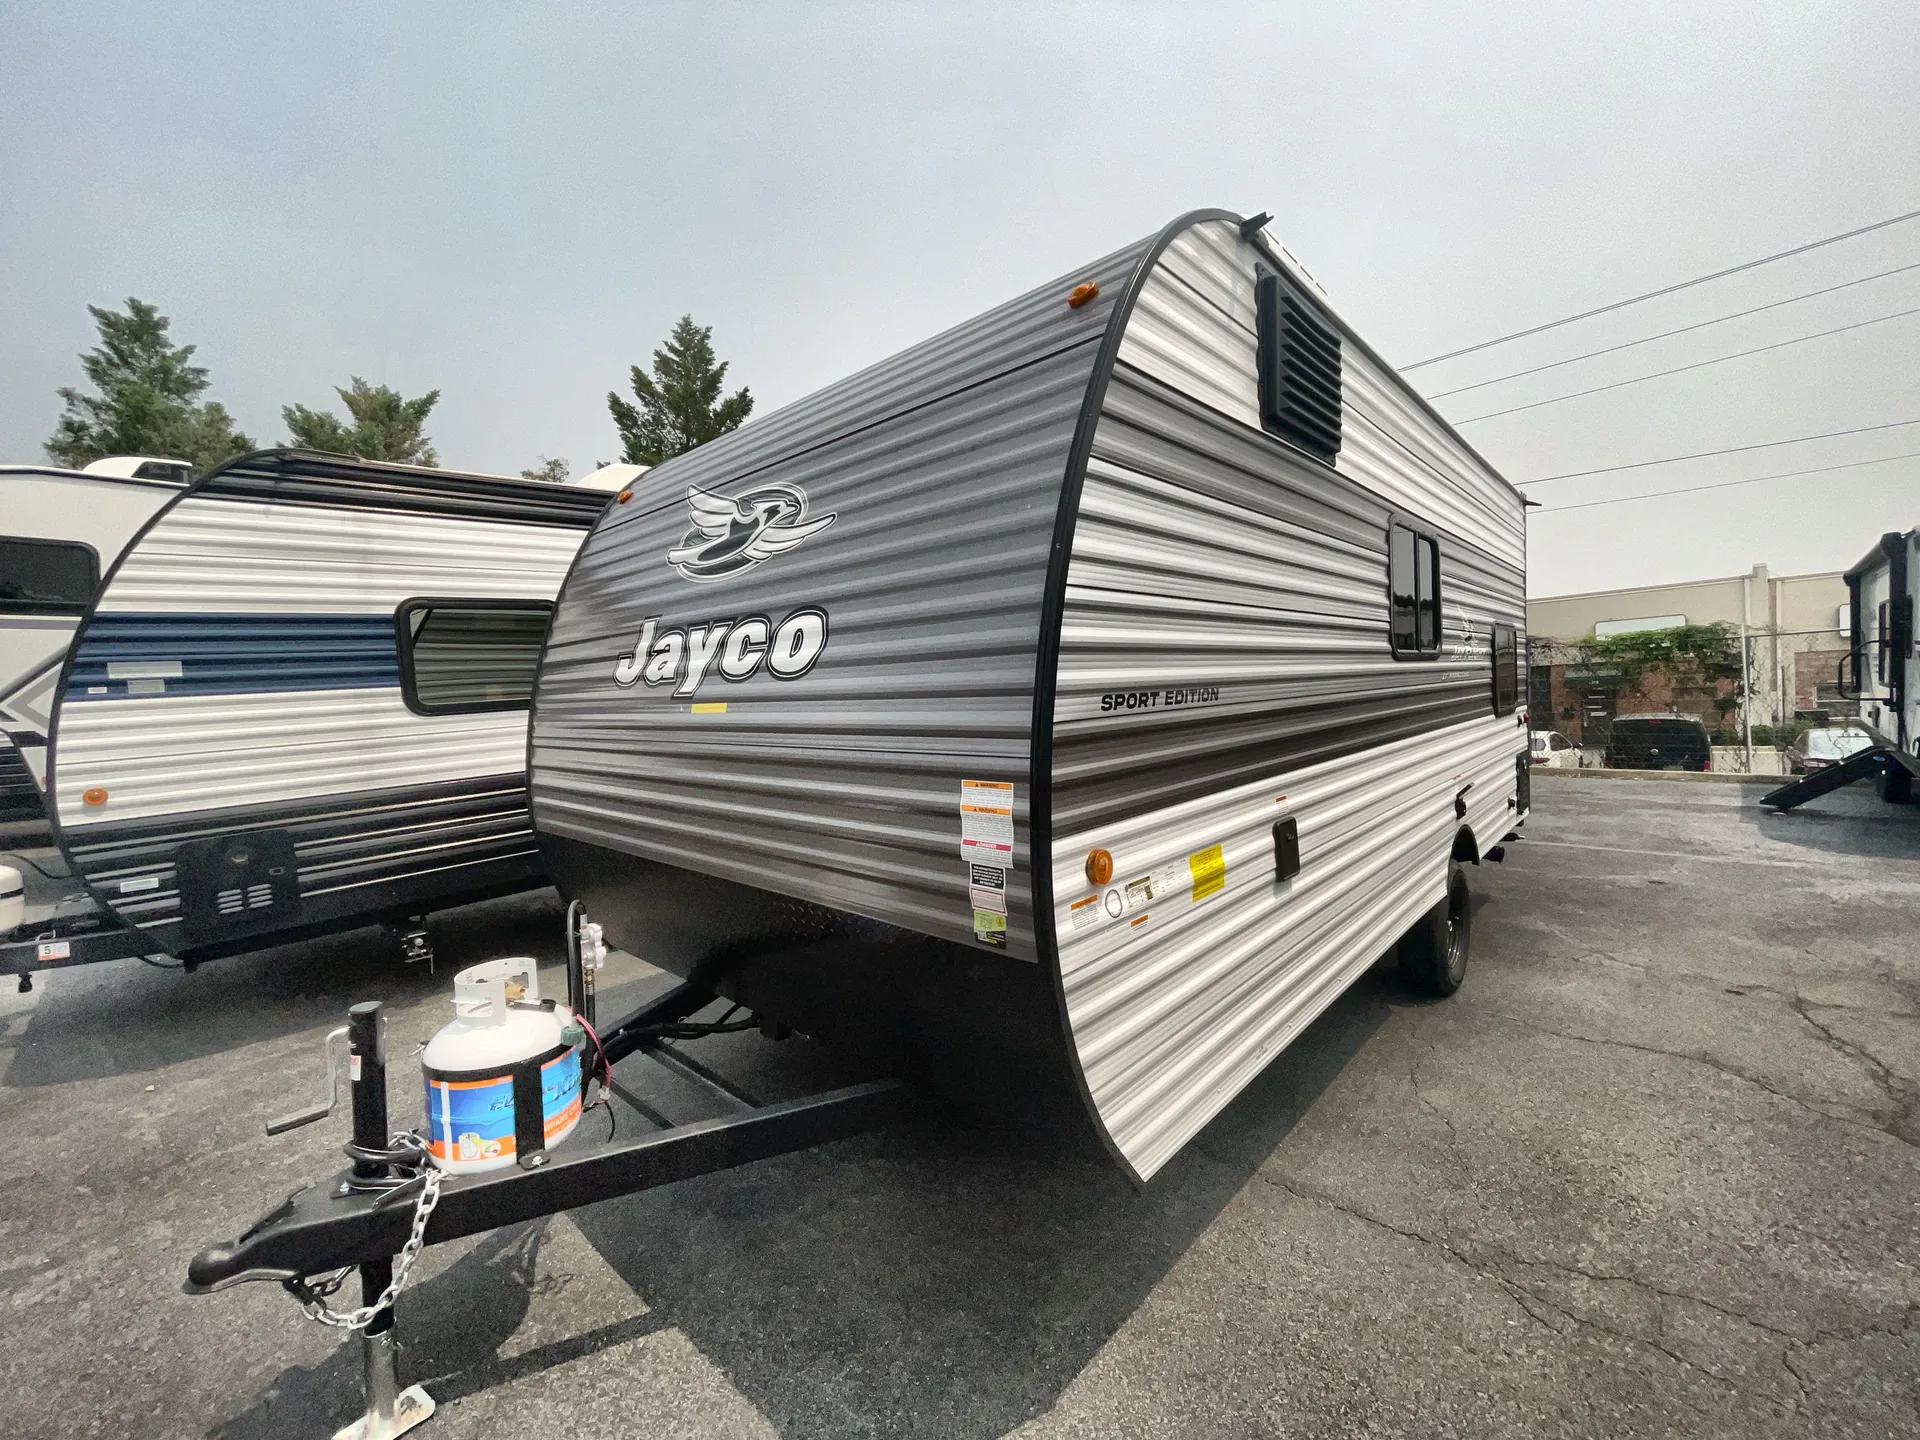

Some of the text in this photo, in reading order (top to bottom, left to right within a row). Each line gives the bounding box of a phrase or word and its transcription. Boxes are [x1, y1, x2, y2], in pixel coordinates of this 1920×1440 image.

[613, 605, 830, 700] Jayco
[1100, 687, 1220, 712] SPORT EDITION
